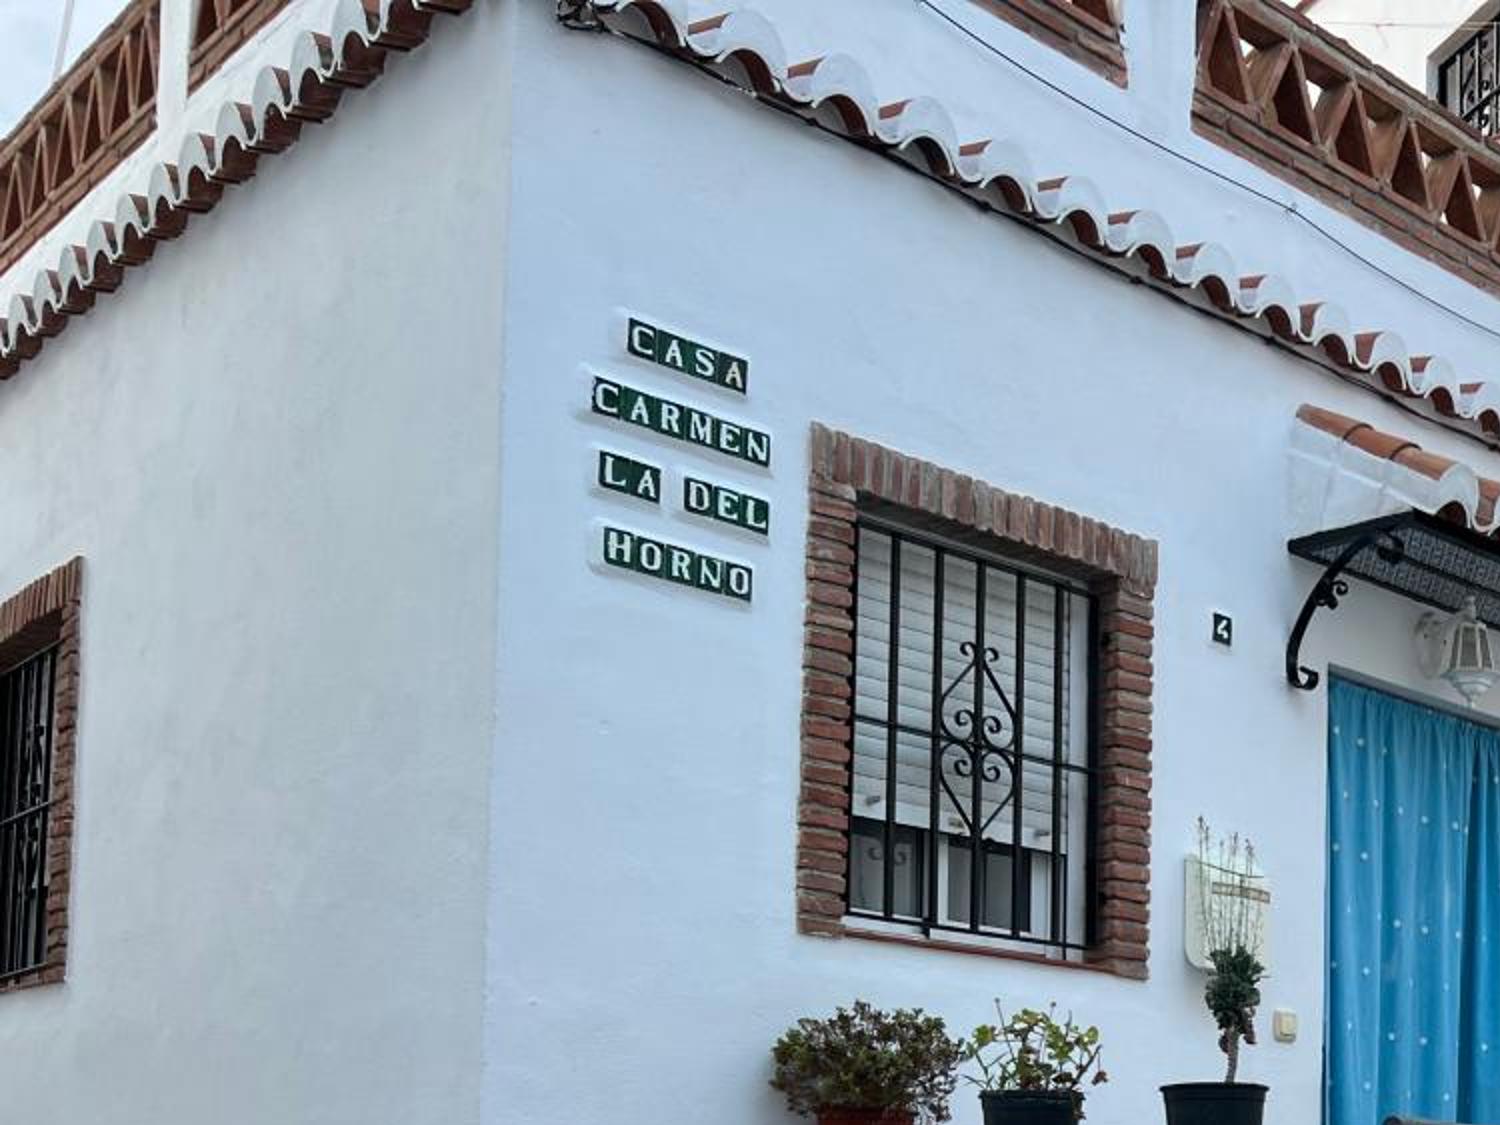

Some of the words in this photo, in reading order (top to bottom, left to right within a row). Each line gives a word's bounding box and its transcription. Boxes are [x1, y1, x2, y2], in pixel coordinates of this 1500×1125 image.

[631, 327, 744, 389] CASA
[595, 383, 768, 462] CARMEN
[603, 456, 657, 499] LA
[688, 481, 767, 529] DEL
[607, 531, 751, 595] HORNO
